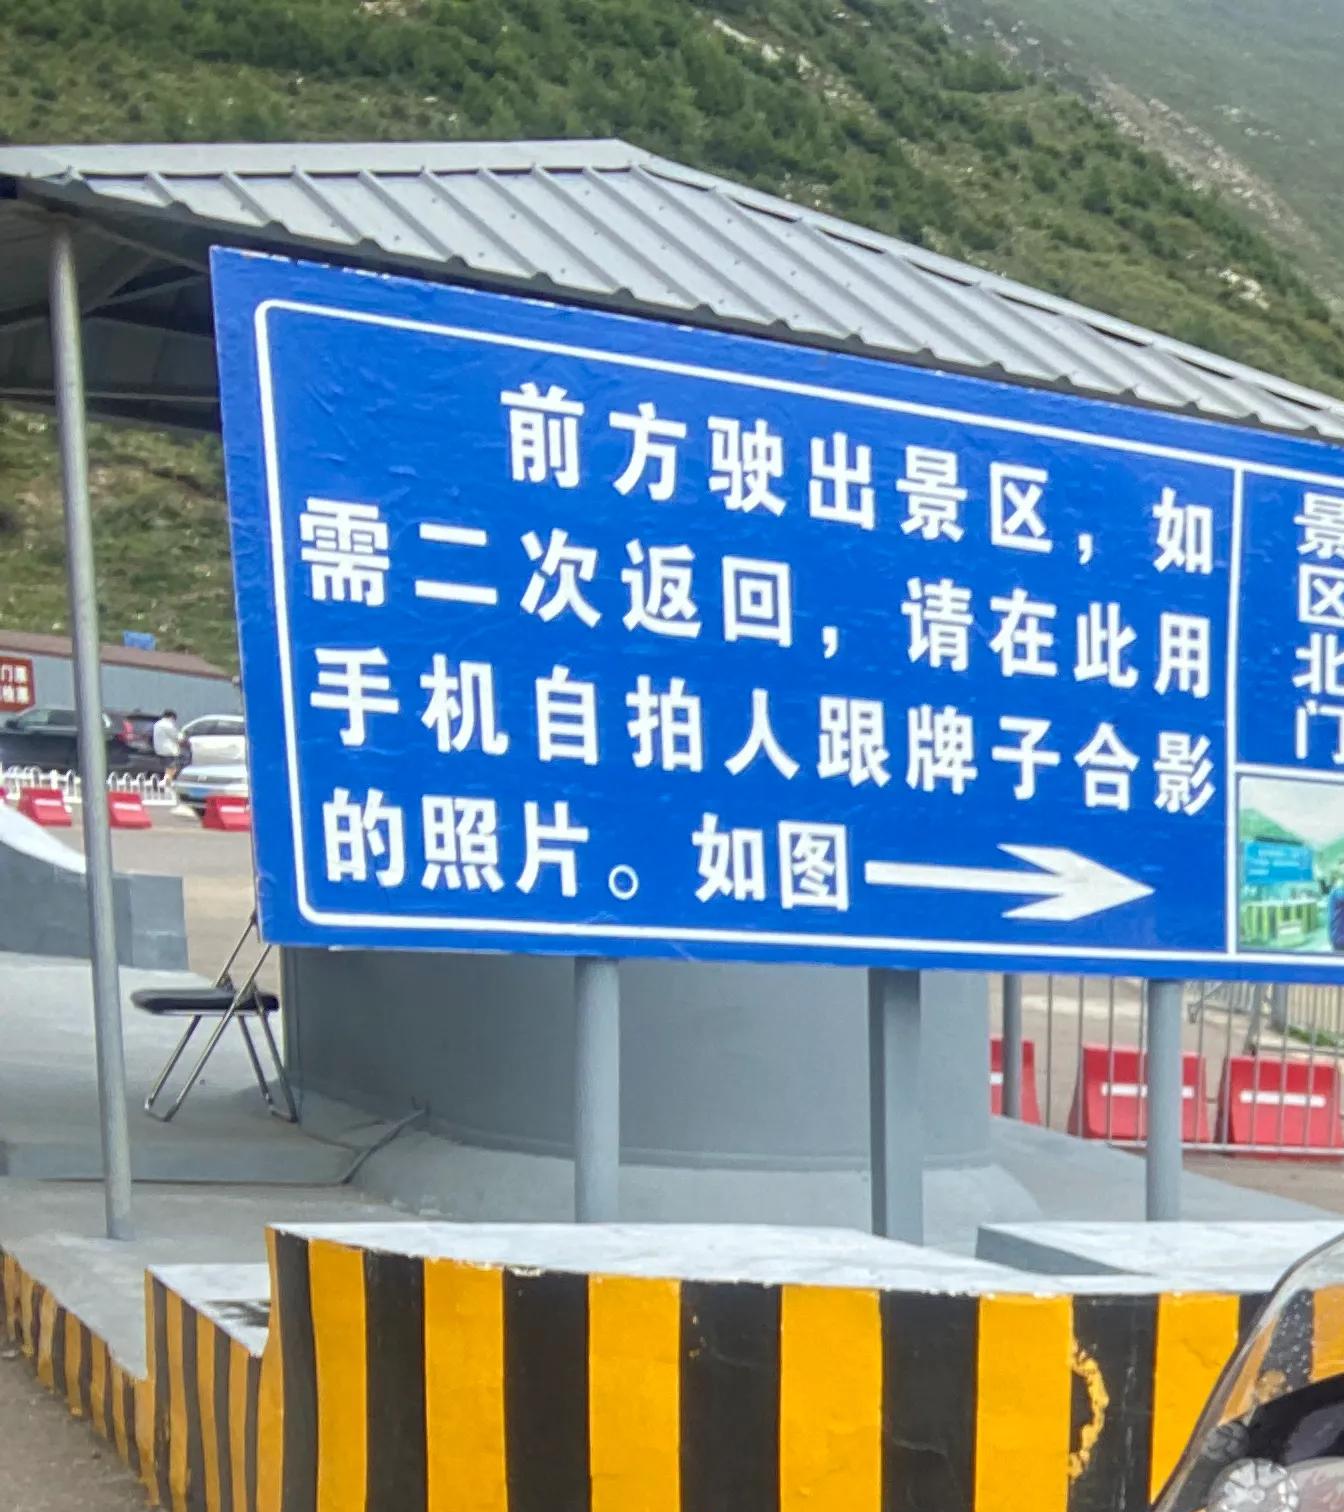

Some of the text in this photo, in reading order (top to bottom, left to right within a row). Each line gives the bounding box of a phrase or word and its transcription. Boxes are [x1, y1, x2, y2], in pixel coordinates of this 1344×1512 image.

[501, 382, 1213, 574] 前方驶出景区，如
[300, 497, 1211, 698] 需二次返回，请在此用
[310, 647, 1216, 816] 手机自拍人跟牌子合影
